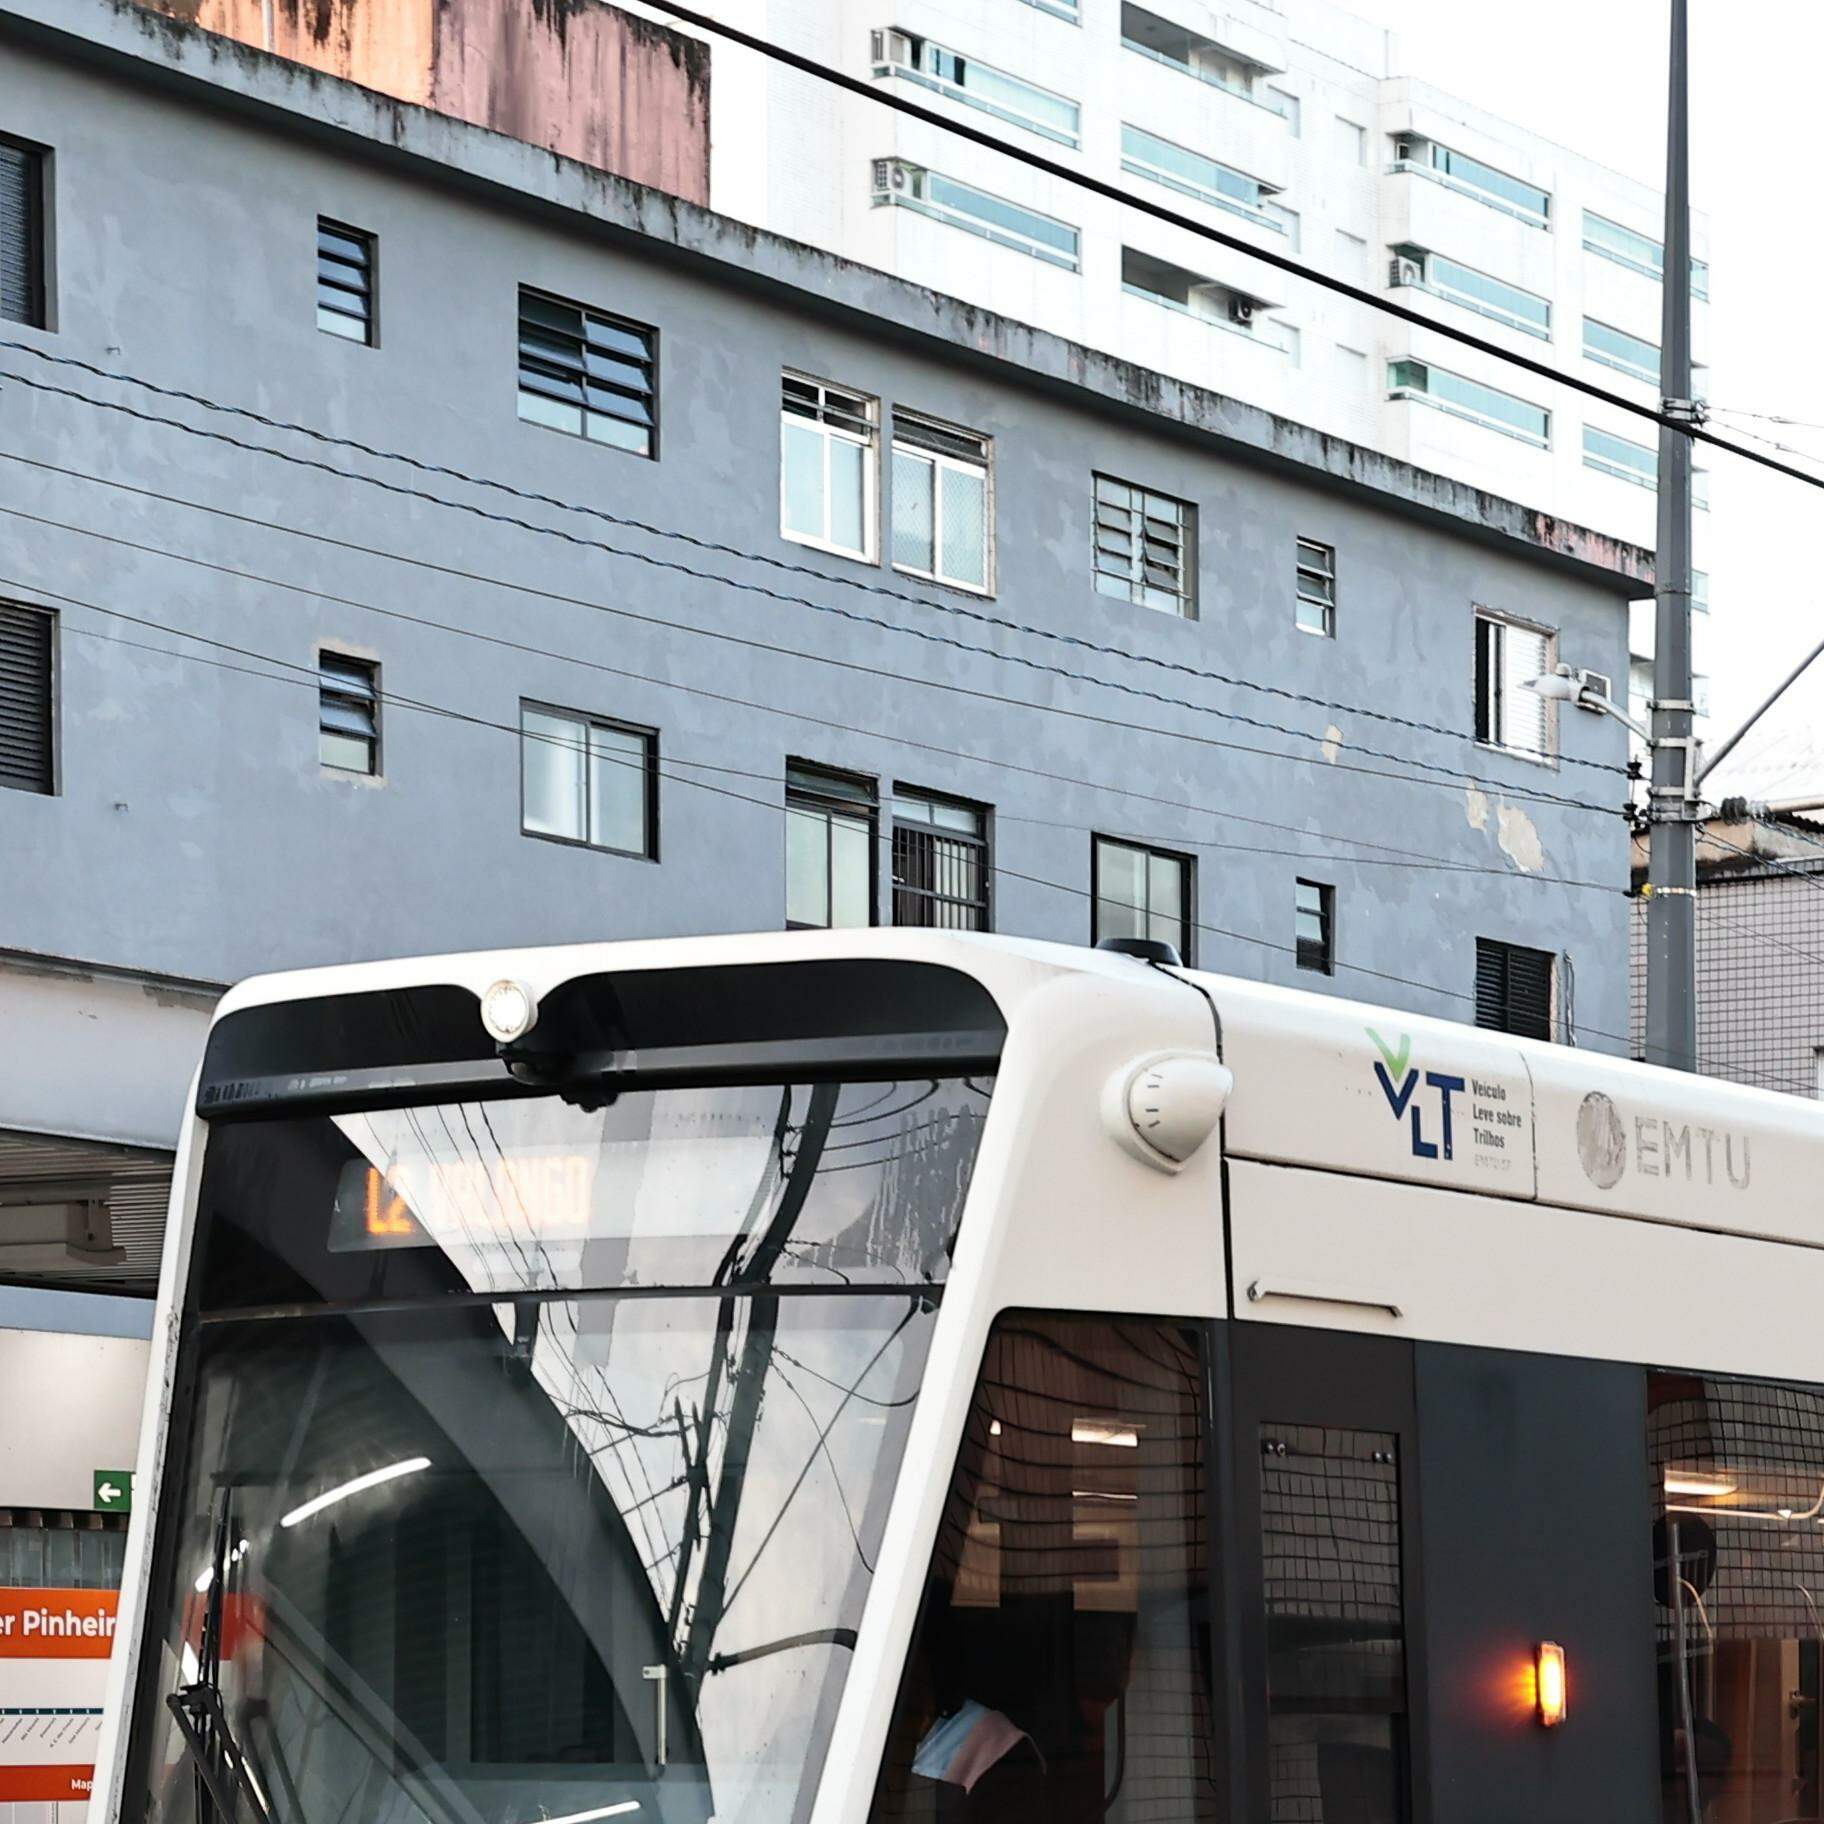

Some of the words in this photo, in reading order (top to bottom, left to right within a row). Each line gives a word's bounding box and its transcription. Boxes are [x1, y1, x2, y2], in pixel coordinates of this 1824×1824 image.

[1374, 1061, 1466, 1161] VLT
[1473, 1104, 1494, 1123] Leve
[1496, 1110, 1522, 1128] sobre
[1473, 1127, 1505, 1148] Trilhos
[1635, 1115, 1751, 1189] EMTU
